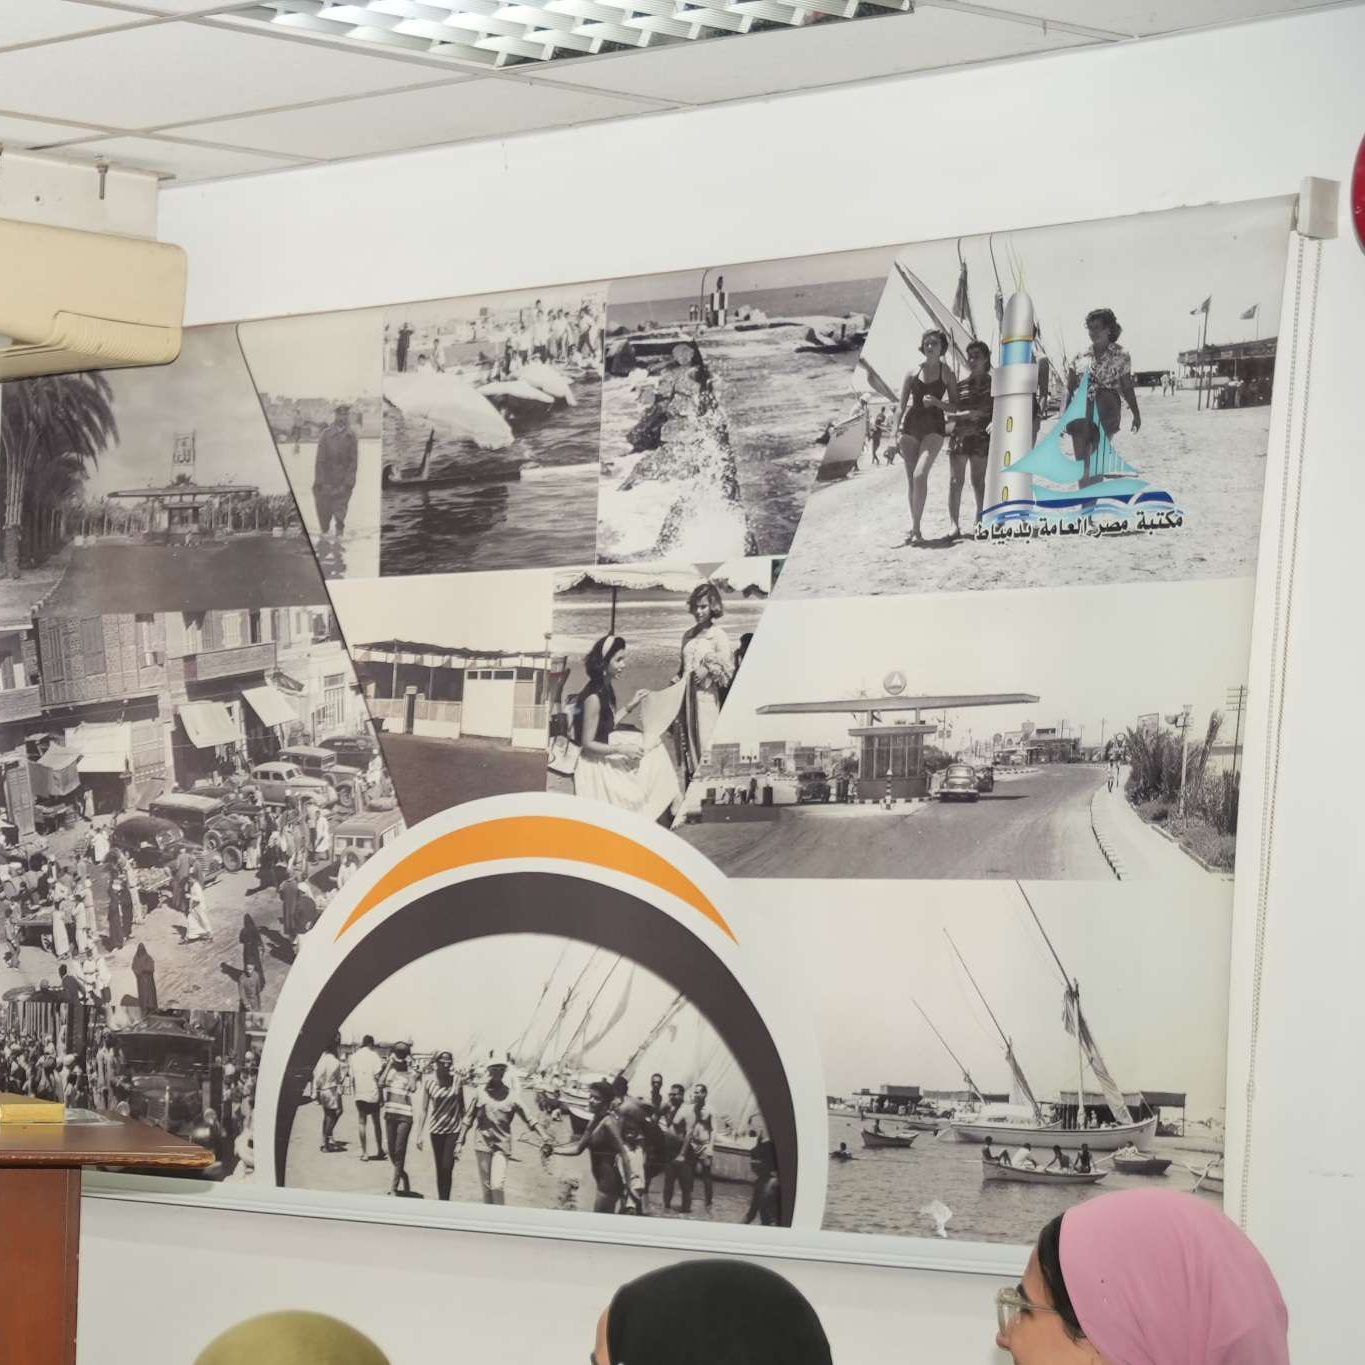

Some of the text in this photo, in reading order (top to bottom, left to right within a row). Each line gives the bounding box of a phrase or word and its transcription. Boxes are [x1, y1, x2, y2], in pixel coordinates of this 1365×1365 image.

[974, 509, 1185, 545] مكتبة مصر العامة بدمياط
